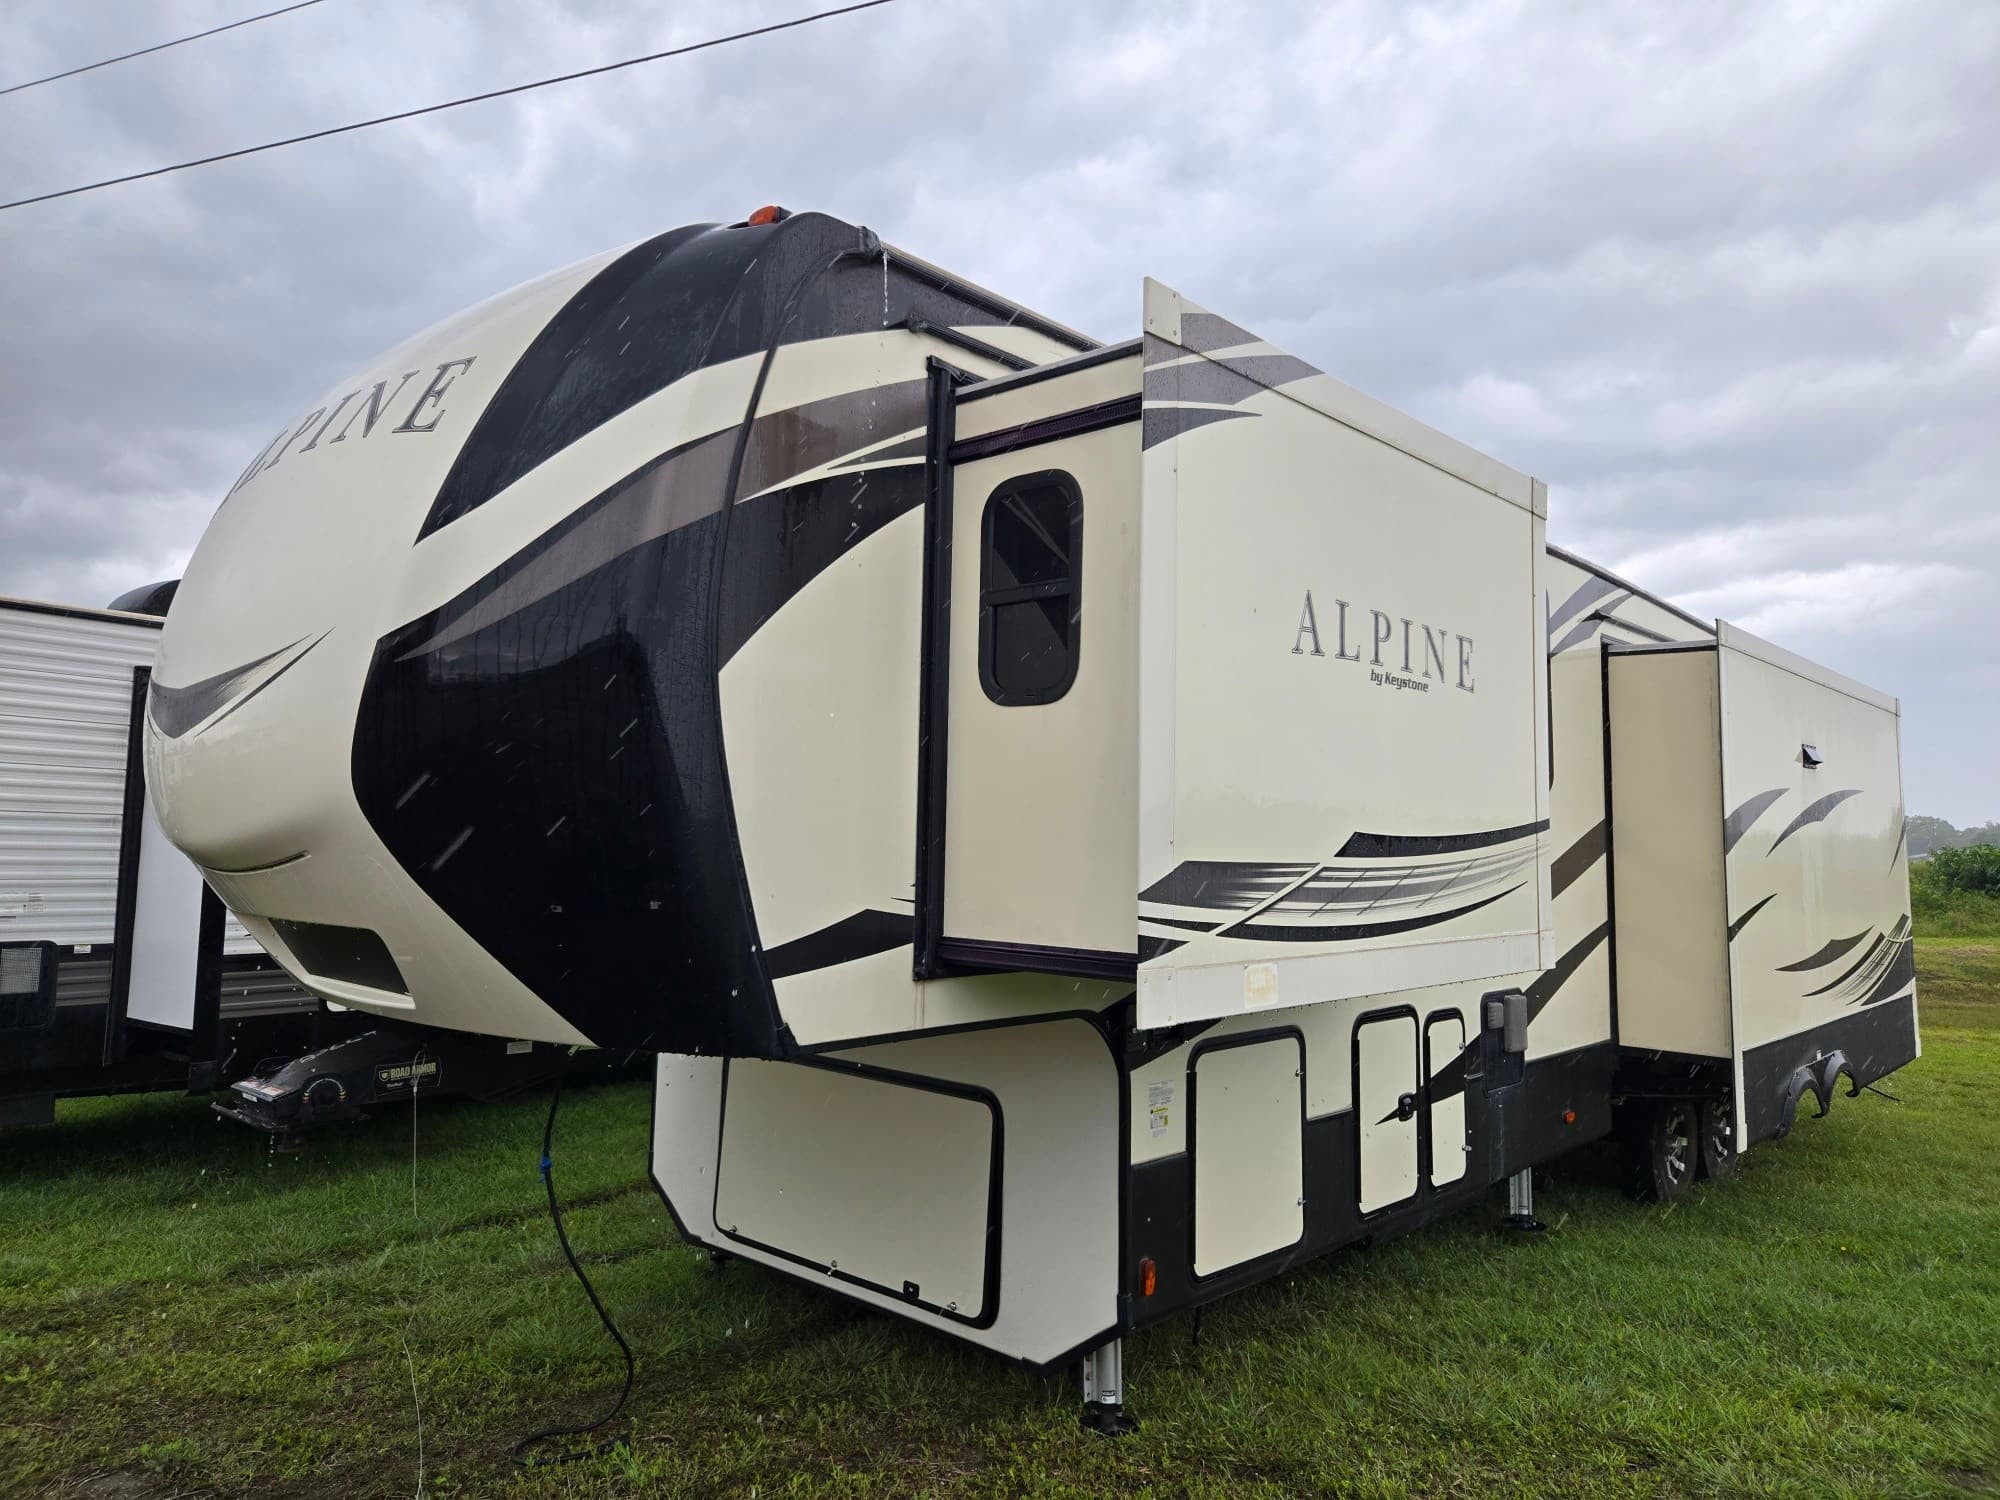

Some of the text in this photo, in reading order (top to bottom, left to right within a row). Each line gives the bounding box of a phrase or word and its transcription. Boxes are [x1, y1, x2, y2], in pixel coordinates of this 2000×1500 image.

[1291, 588, 1476, 694] ALPINE
[1370, 668, 1429, 693] by Keystone
[390, 1066, 411, 1079] ROAD
